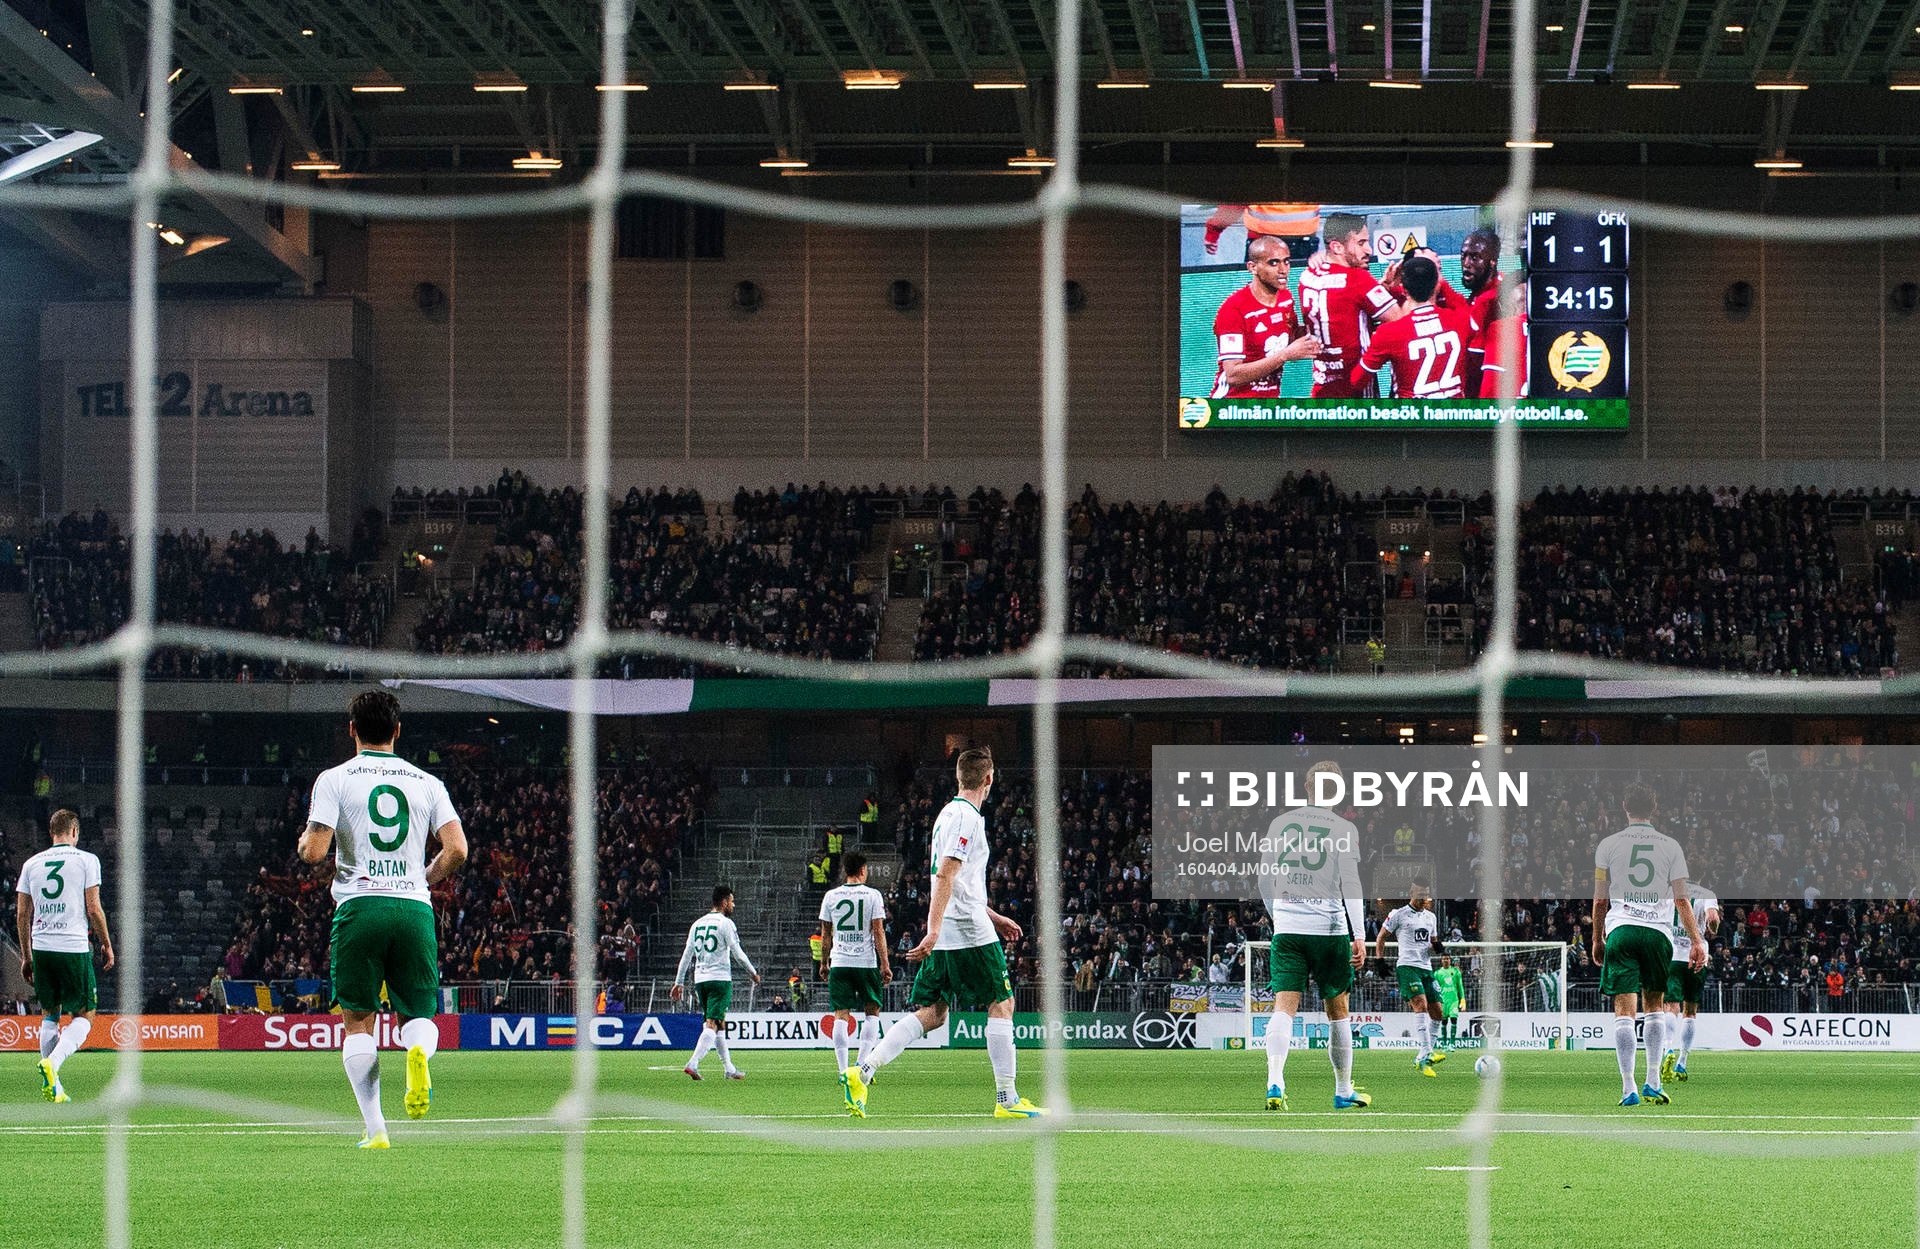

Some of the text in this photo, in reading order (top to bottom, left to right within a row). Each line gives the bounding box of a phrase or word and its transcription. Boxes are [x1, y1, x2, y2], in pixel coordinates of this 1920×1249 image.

[1532, 210, 1626, 226] HIF ÖFK
[1544, 235, 1556, 263] 1
[1599, 235, 1611, 263] 1
[1545, 286, 1614, 310] 34:15
[1408, 330, 1462, 395] 22
[77, 371, 315, 417] TEL2 Arena
[1218, 405, 1588, 423] allmän information besök hammarbyfotboll.se.
[424, 522, 454, 535] B319
[1390, 522, 1420, 535] B317
[1875, 523, 1905, 536] B316
[367, 783, 410, 852] 9
[1278, 822, 1331, 872] 23
[368, 859, 407, 877] BATAN
[1627, 844, 1655, 888] 5
[41, 860, 66, 900] 3
[1623, 891, 1659, 904] HAGLUND
[39, 902, 67, 915] MAGYAR
[835, 898, 865, 932] 21
[694, 925, 719, 953] 55
[141, 1024, 204, 1039] SYNSAM
[724, 1020, 819, 1040] PELIKAN
[953, 1019, 1127, 1040] AuomPendax
[1782, 1016, 1891, 1038] SAFECON
[1316, 1038, 1363, 1048] KVEN
[1376, 1039, 1421, 1048] KVARNEN
[1436, 1039, 1481, 1048] KRNEN
[1501, 1039, 1546, 1048] KVARNEN
